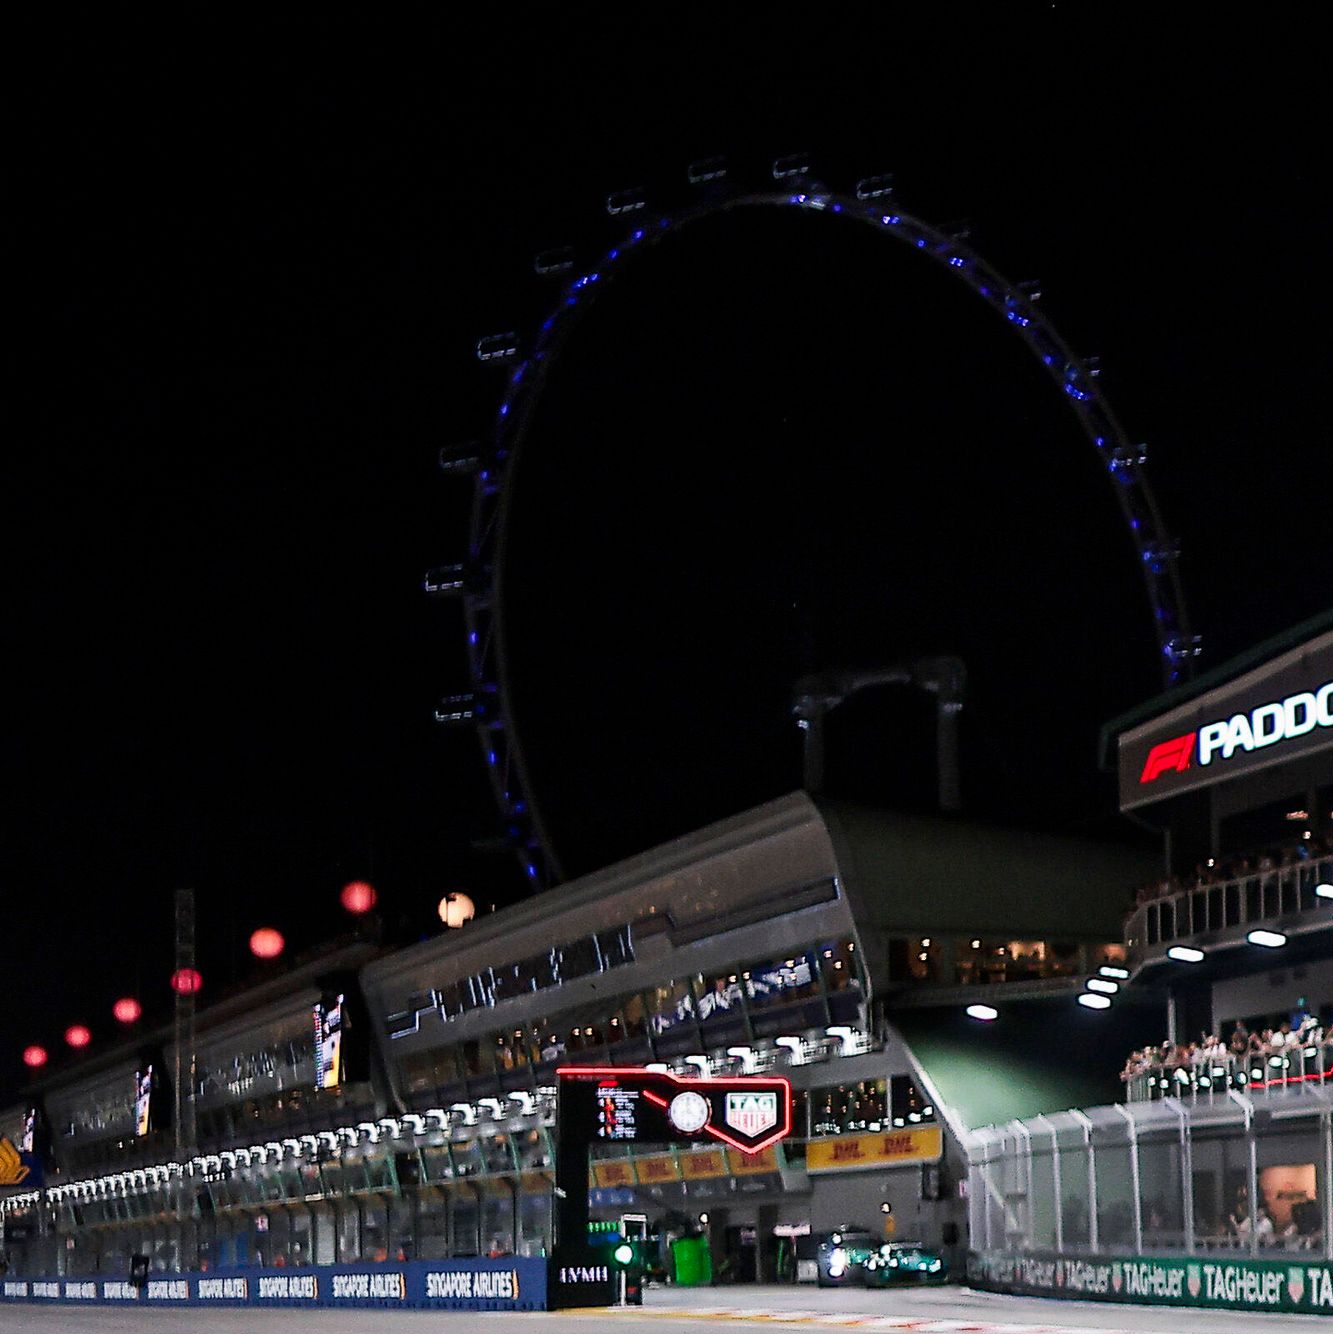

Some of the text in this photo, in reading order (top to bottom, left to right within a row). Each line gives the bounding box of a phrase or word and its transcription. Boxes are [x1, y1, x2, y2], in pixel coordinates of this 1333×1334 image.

[731, 1094, 774, 1110] TAG
[426, 1270, 512, 1299] SINGAPORE AIRLINES
